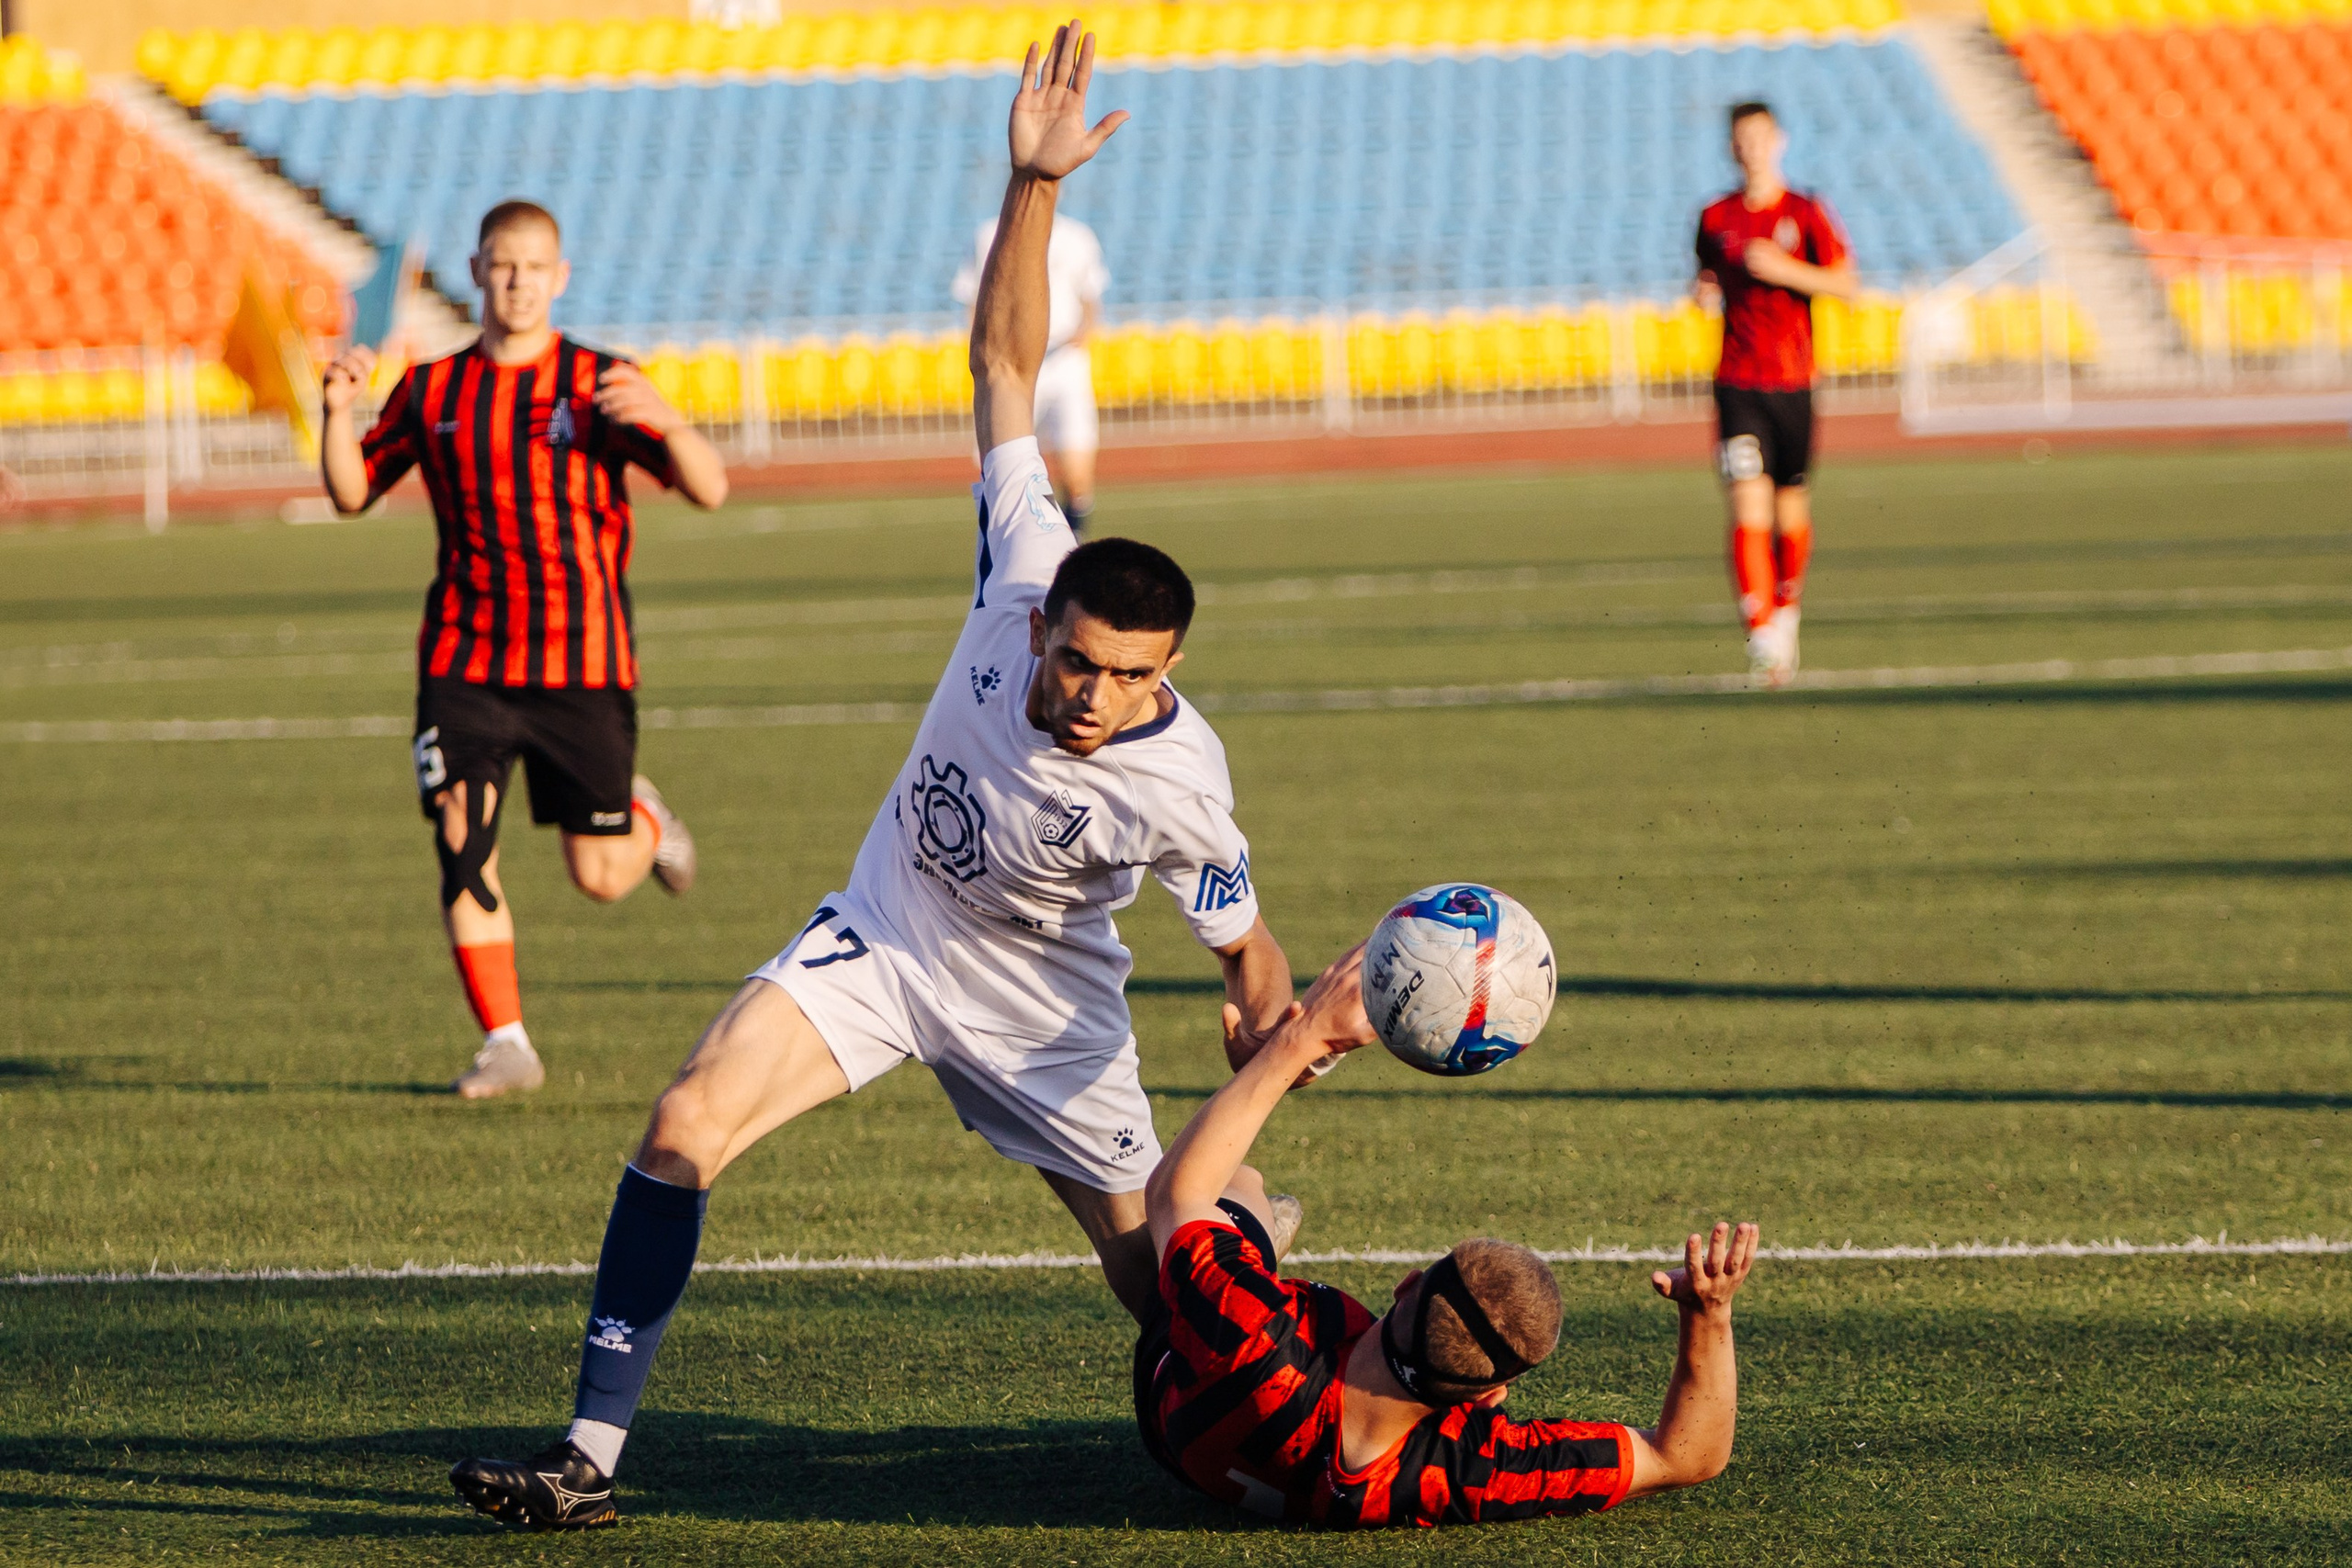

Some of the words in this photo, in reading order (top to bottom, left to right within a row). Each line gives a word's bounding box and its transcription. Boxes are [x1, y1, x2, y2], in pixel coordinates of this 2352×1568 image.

[970, 666, 985, 706] KELME
[1383, 970, 1424, 1042] DEMIX
[1110, 1142, 1145, 1163] KELME
[589, 1335, 632, 1354] KELME
